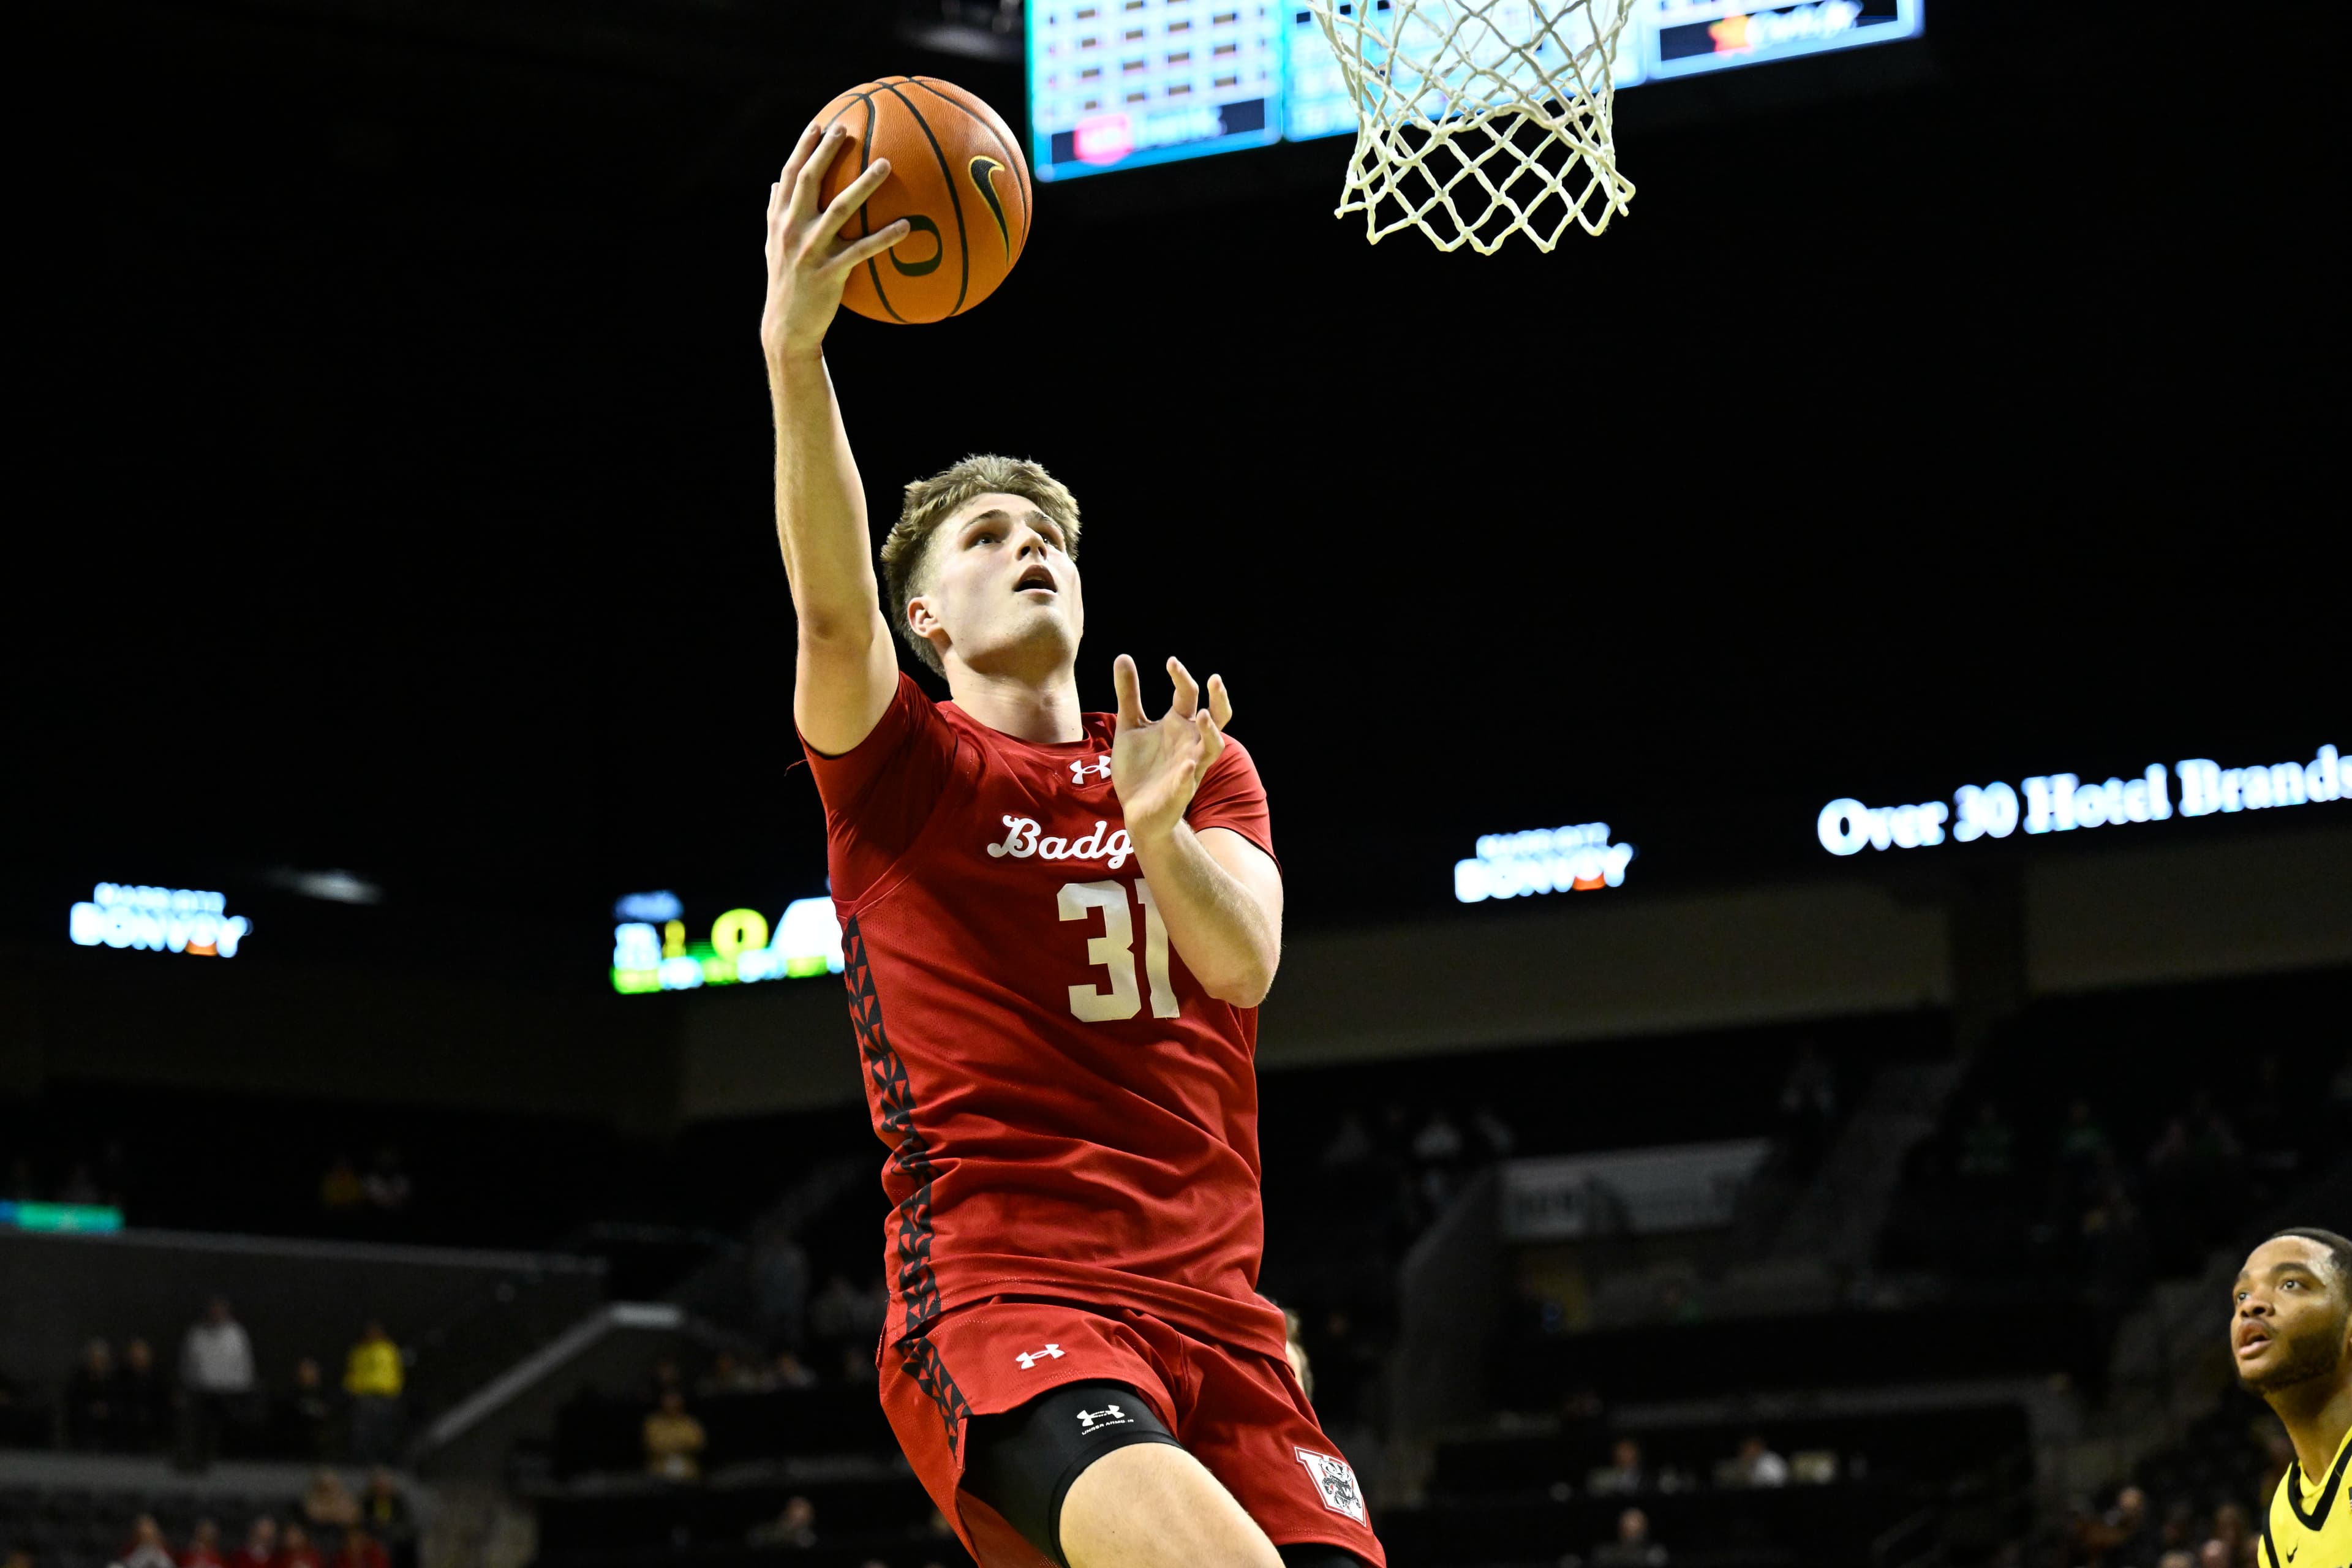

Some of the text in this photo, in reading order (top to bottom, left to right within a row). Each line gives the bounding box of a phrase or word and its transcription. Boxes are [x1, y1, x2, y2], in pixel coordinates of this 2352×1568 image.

[1817, 798, 1949, 856] Over
[1953, 781, 2019, 842] 30
[2021, 763, 2173, 834] Hotel
[1057, 878, 1180, 1022] 31
